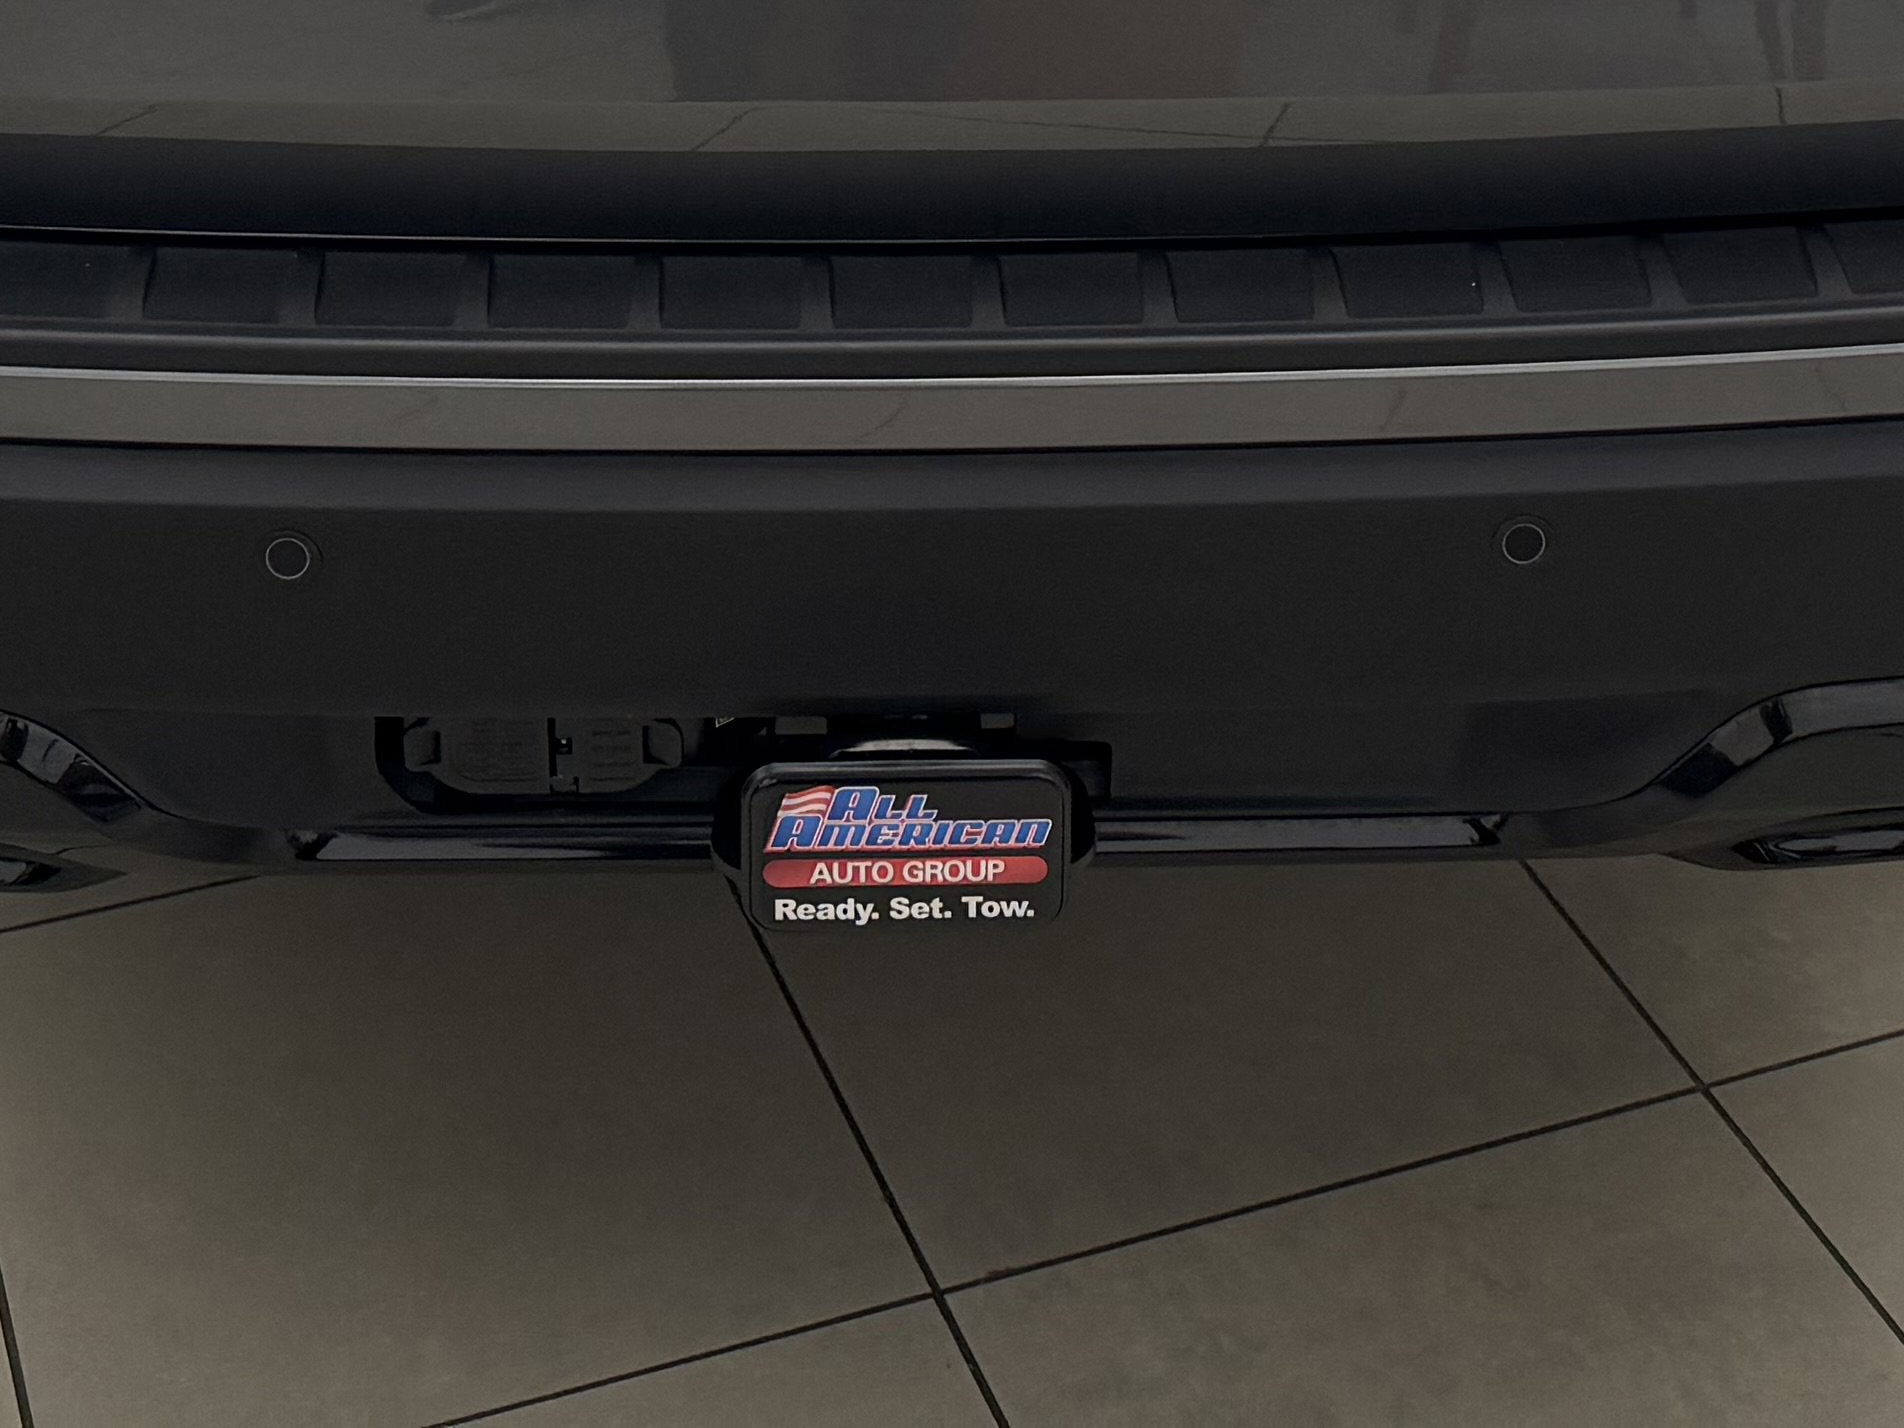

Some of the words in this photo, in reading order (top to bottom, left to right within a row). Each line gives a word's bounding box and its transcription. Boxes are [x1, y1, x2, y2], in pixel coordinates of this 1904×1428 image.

[809, 861, 894, 886] AUTO
[902, 859, 1007, 884] GROUP
[774, 897, 880, 926] Ready.
[890, 896, 952, 920] Set.
[962, 895, 1035, 919] Tow.
